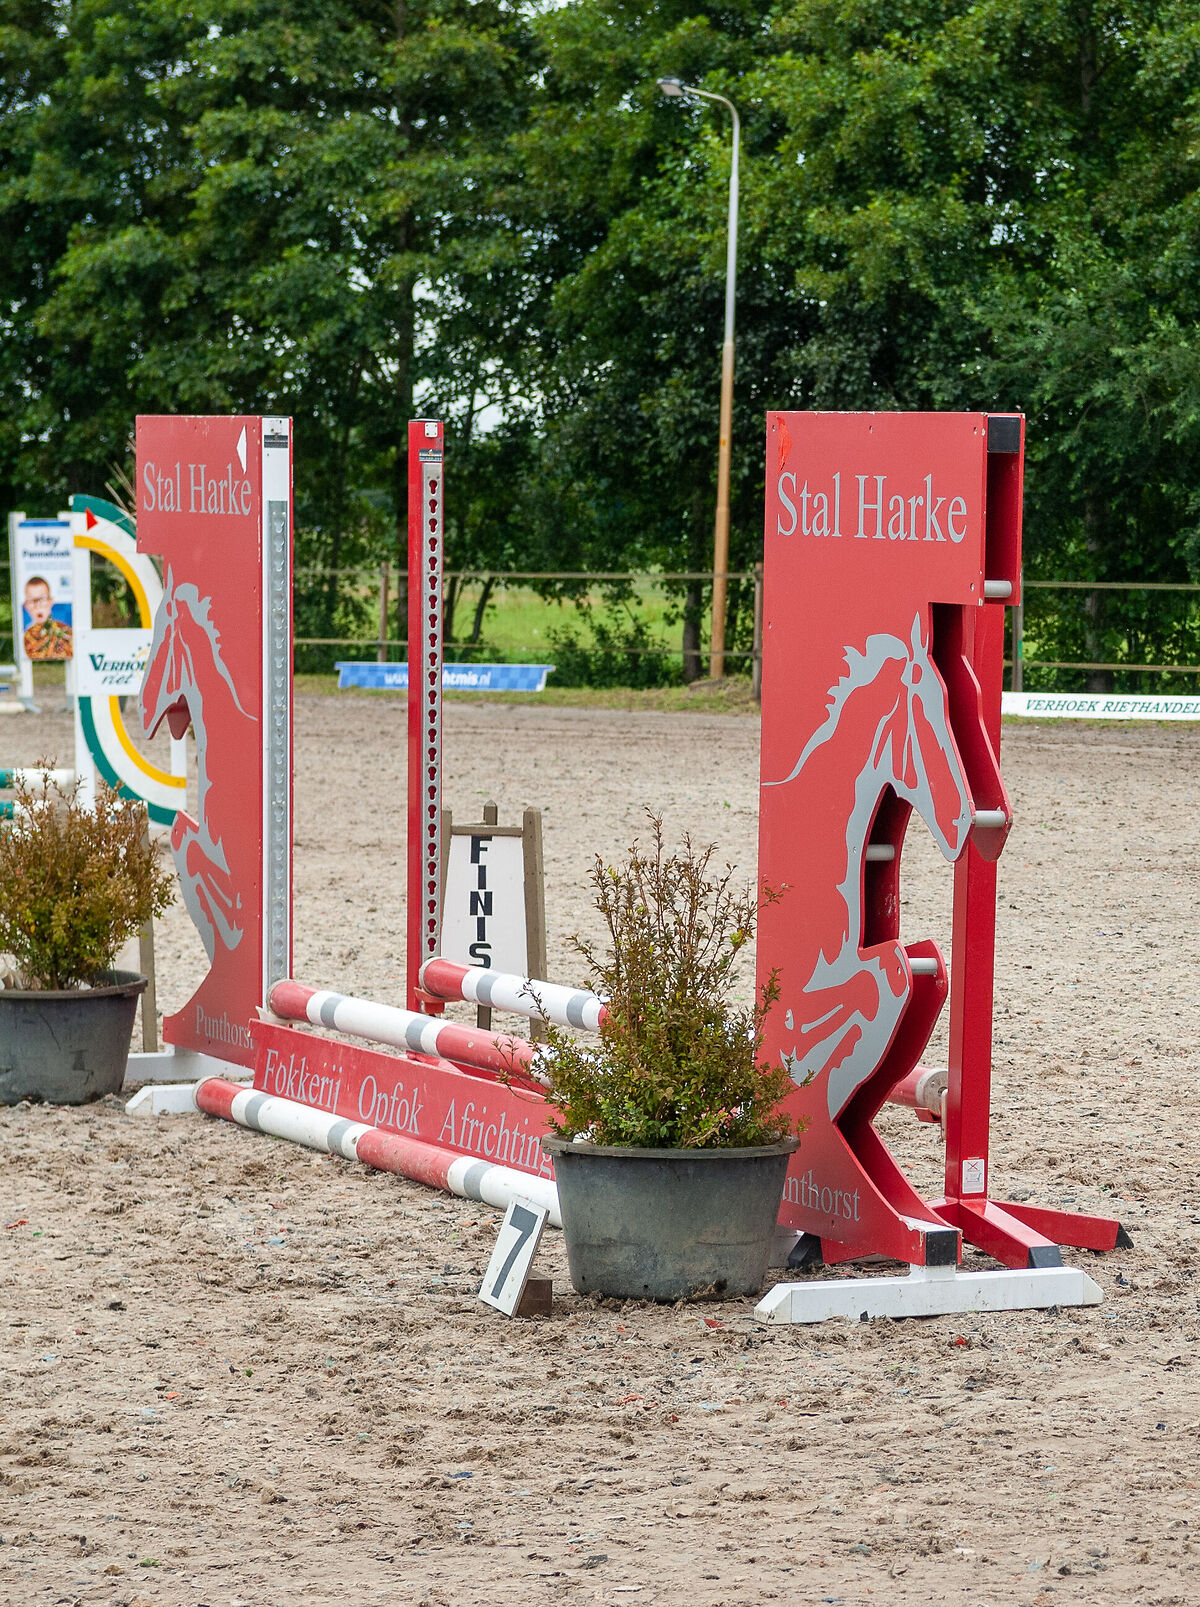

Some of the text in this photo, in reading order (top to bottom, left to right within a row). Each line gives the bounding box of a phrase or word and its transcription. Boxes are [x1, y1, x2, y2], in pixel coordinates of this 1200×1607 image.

[143, 461, 252, 516] Stal Harke
[777, 471, 968, 544] Stal Harke
[1025, 699, 1101, 713] VERHOEK
[468, 835, 493, 969] FINIS
[261, 1048, 344, 1115] Fokkerij
[358, 1074, 424, 1135] Opfok
[782, 1169, 861, 1222] nthorst
[490, 1203, 539, 1300] 7
